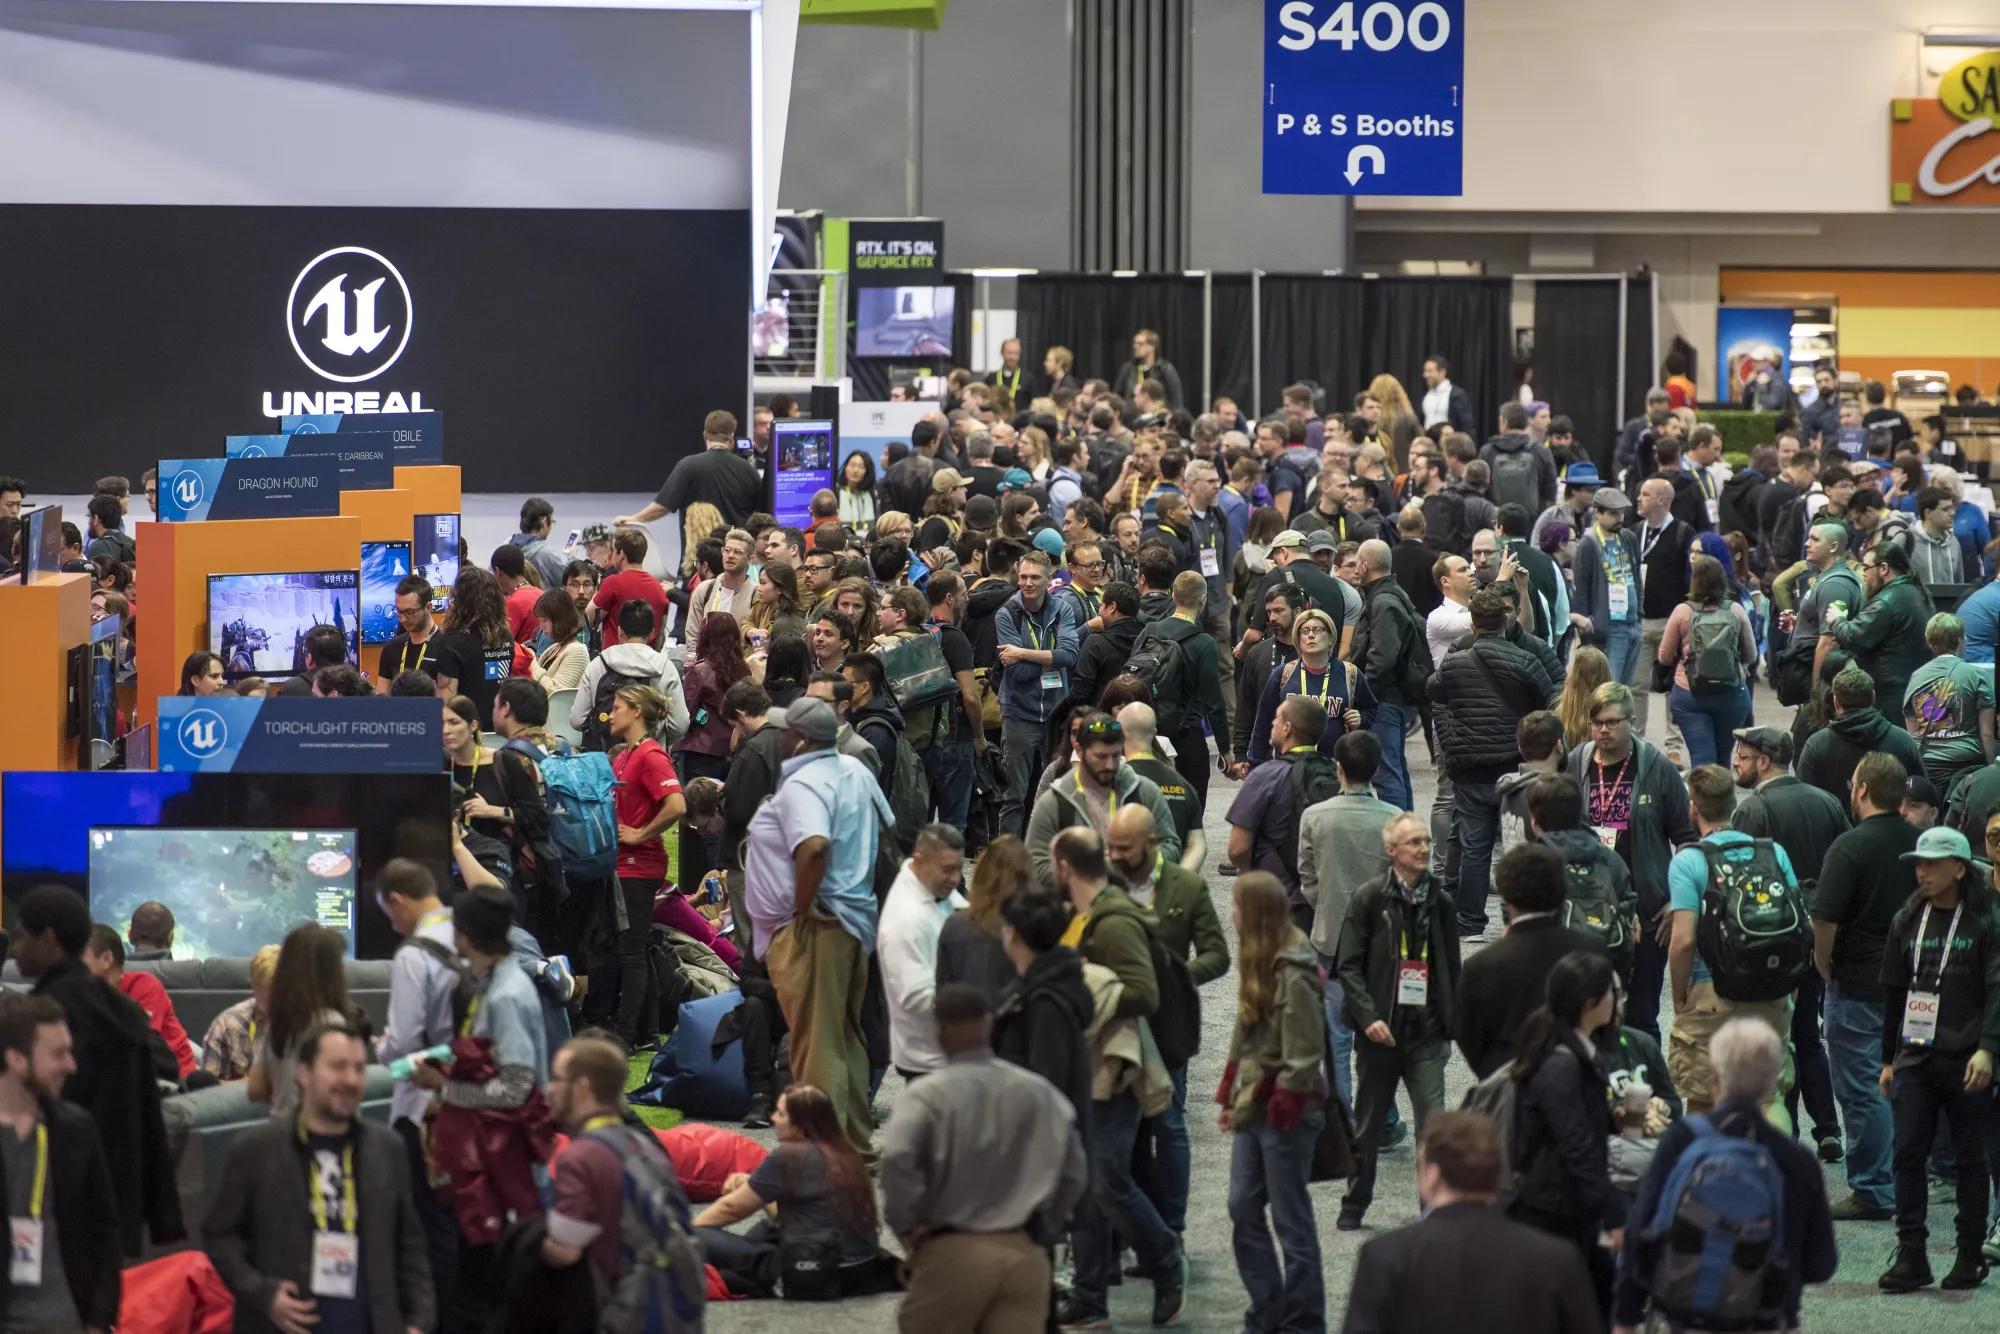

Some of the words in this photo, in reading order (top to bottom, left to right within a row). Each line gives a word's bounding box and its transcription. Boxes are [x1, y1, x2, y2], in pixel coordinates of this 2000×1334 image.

[1278, 2, 1450, 52] S400
[1960, 66, 2000, 115] SA
[1277, 113, 1295, 135] P
[1302, 113, 1322, 136] &
[1330, 114, 1347, 136] S
[1357, 114, 1455, 137] Booths
[856, 241, 887, 256] RTX.
[856, 256, 909, 269] GEFORCE
[911, 256, 934, 269] RTX
[263, 391, 435, 418] UNREAL
[392, 430, 422, 442] OBILE
[344, 452, 384, 461] CARIBBEAN
[238, 477, 281, 490] DRAGON
[283, 476, 319, 489] HOUND
[264, 721, 348, 735] TORCHLIGHT
[351, 721, 426, 735] FRONTIERS
[1160, 785, 1186, 795] ALDEV
[1600, 835, 1614, 845] DC
[1401, 968, 1427, 980] GDC
[1908, 1000, 1937, 1013] GDC
